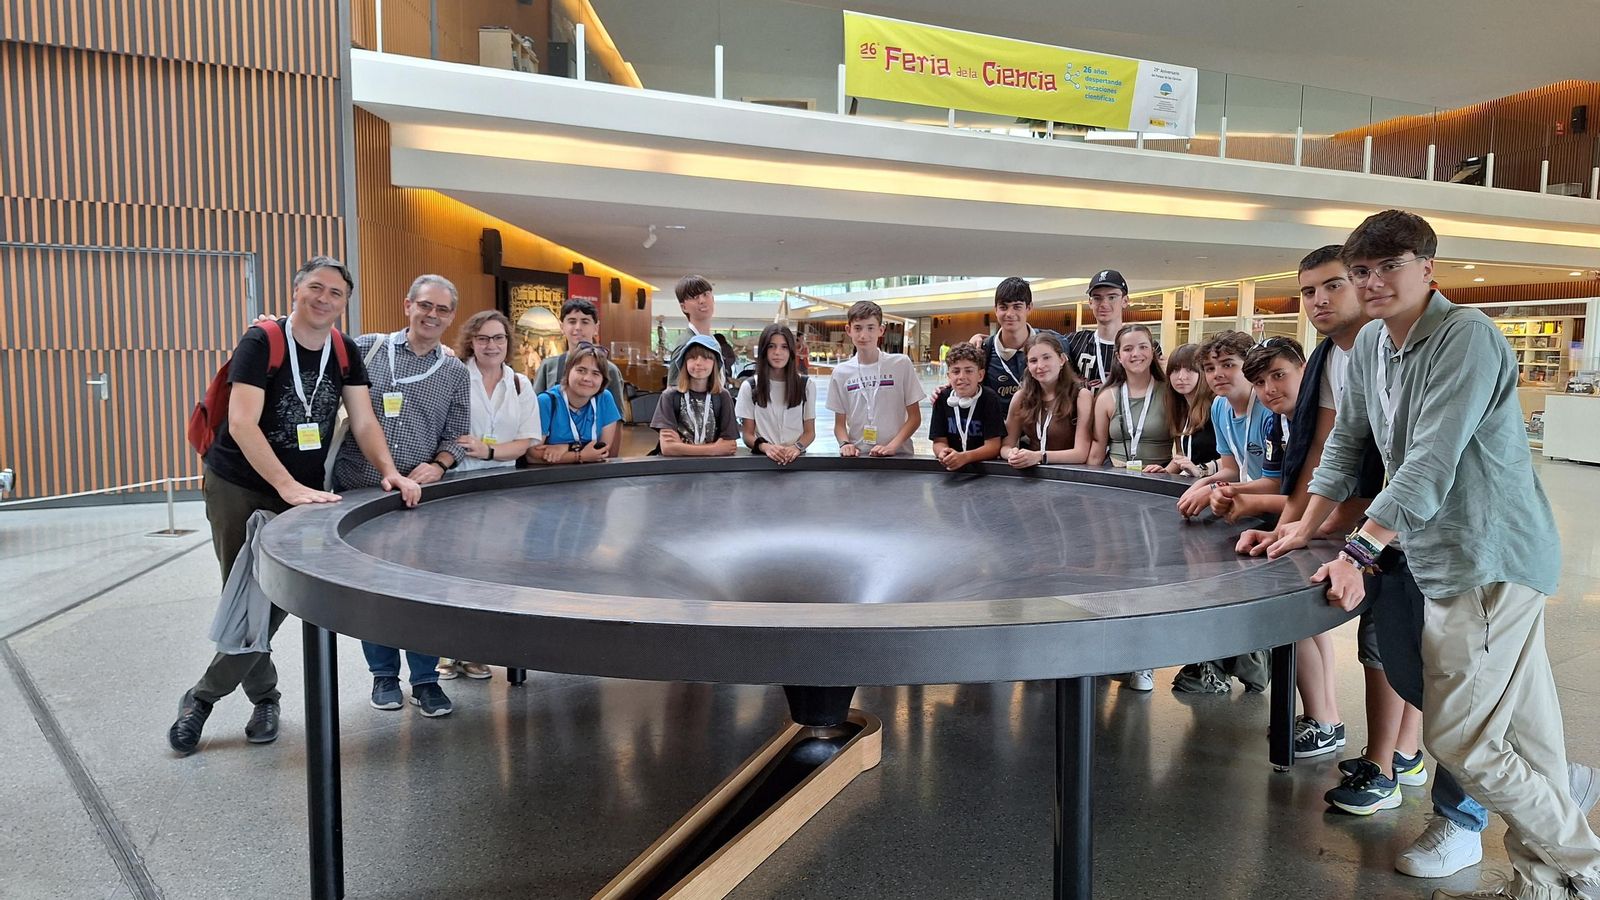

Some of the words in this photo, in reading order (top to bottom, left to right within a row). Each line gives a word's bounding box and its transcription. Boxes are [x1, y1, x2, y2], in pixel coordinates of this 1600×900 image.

[885, 46, 951, 76] Feria
[983, 61, 1057, 91] Ciencia
[1083, 65, 1092, 74] 26
[1085, 76, 1122, 86] despertando
[1085, 86, 1117, 94] vocaciones
